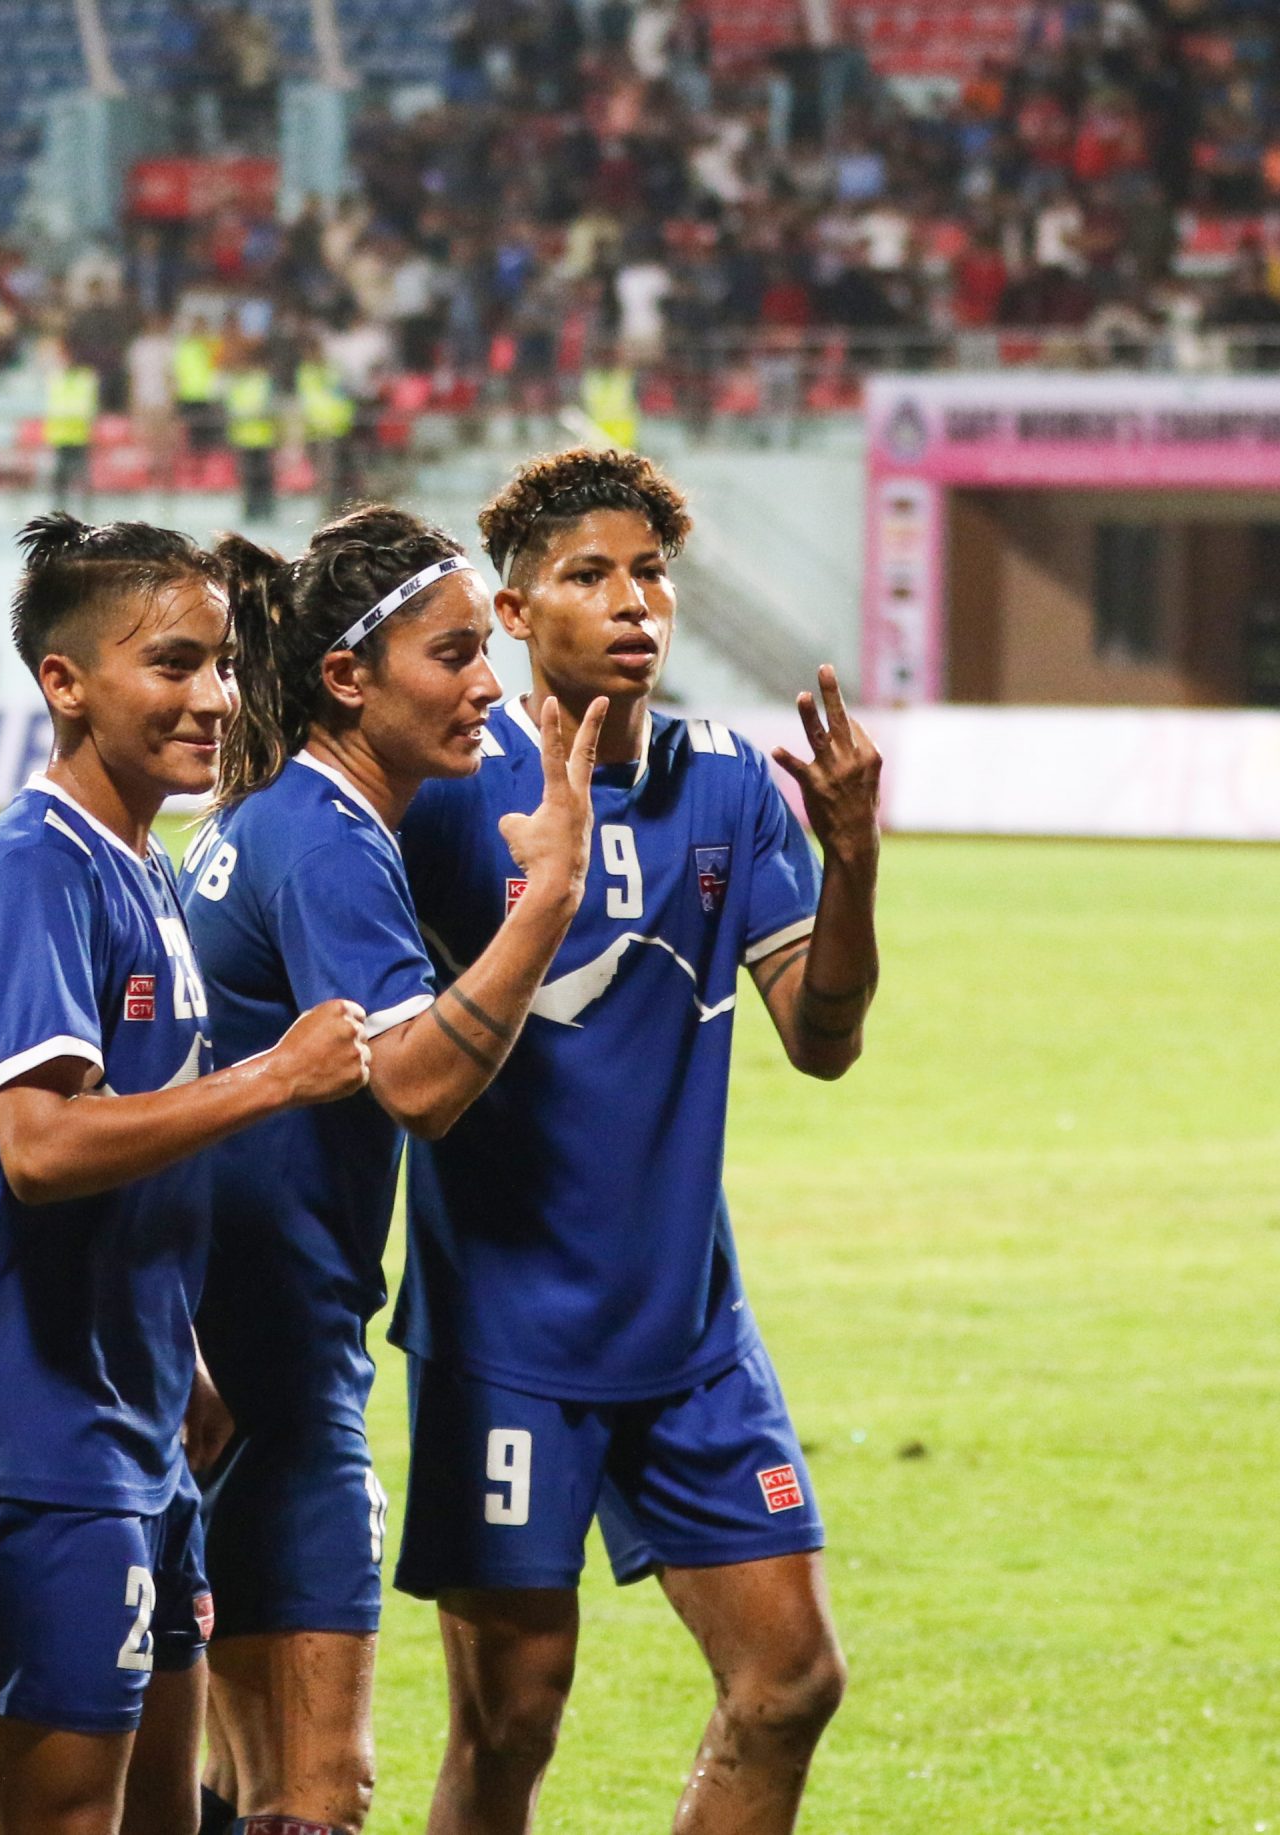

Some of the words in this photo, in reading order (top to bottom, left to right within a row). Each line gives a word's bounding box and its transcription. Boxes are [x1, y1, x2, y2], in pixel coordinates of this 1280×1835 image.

[438, 559, 459, 573] NIKE
[400, 577, 422, 600] NIKE
[362, 606, 384, 632] NIKE
[600, 824, 643, 919] 9
[130, 1003, 154, 1016] CTY
[484, 1428, 533, 1526] 9
[763, 1470, 795, 1487] KTM
[771, 1491, 798, 1507] CTY
[116, 1565, 157, 1672] 2
